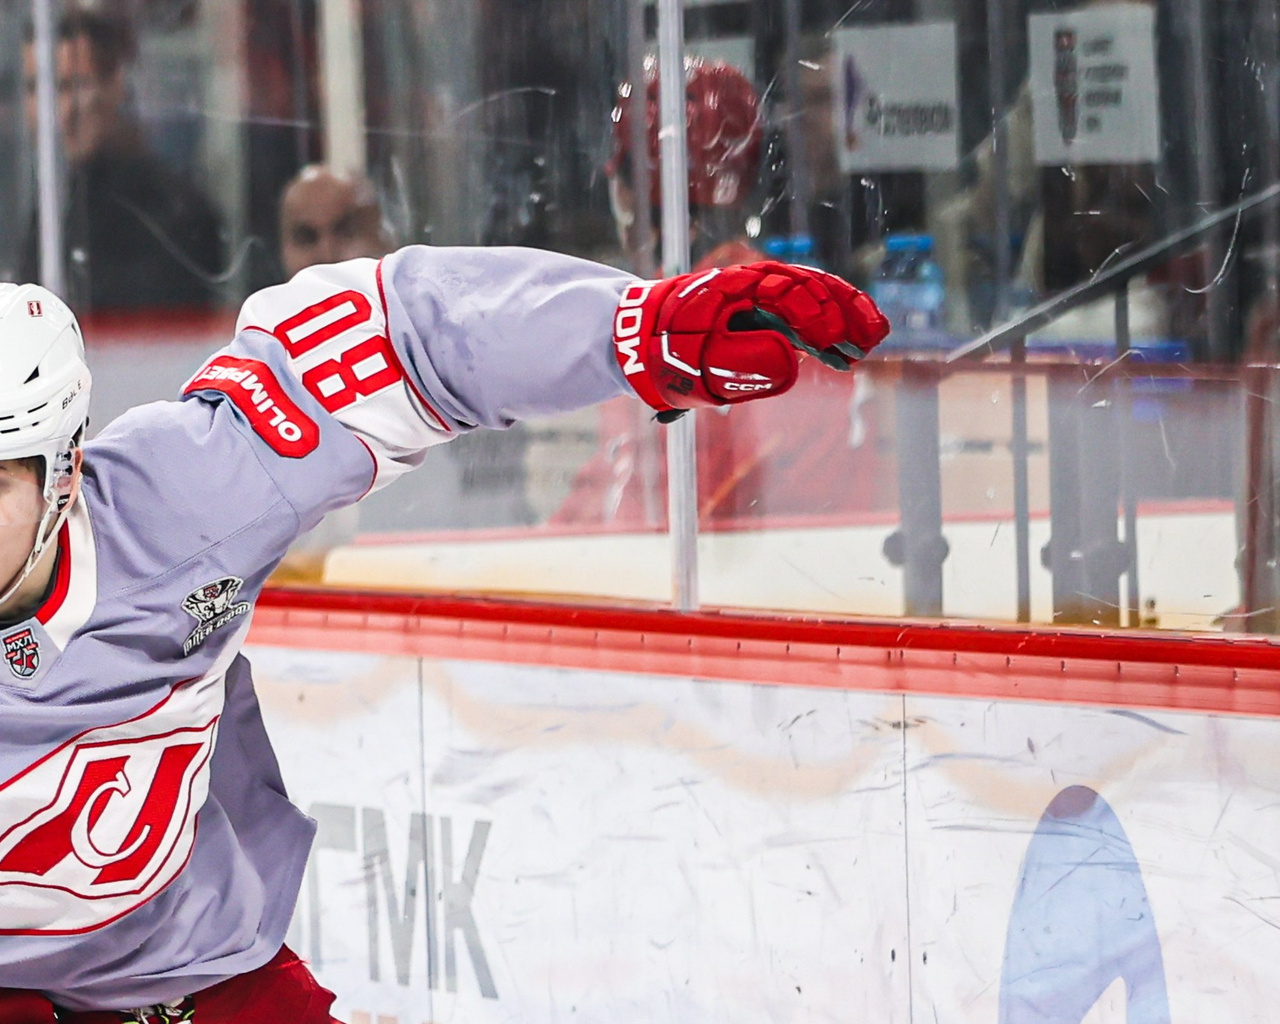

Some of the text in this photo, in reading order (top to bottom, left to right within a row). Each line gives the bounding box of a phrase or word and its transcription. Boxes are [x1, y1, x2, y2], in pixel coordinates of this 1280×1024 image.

[273, 290, 403, 415] 80
[723, 381, 773, 392] CCM
[194, 365, 303, 443] OLIMPBET
[6, 635, 33, 652] МХЛ
[298, 803, 500, 1000] ГМК
